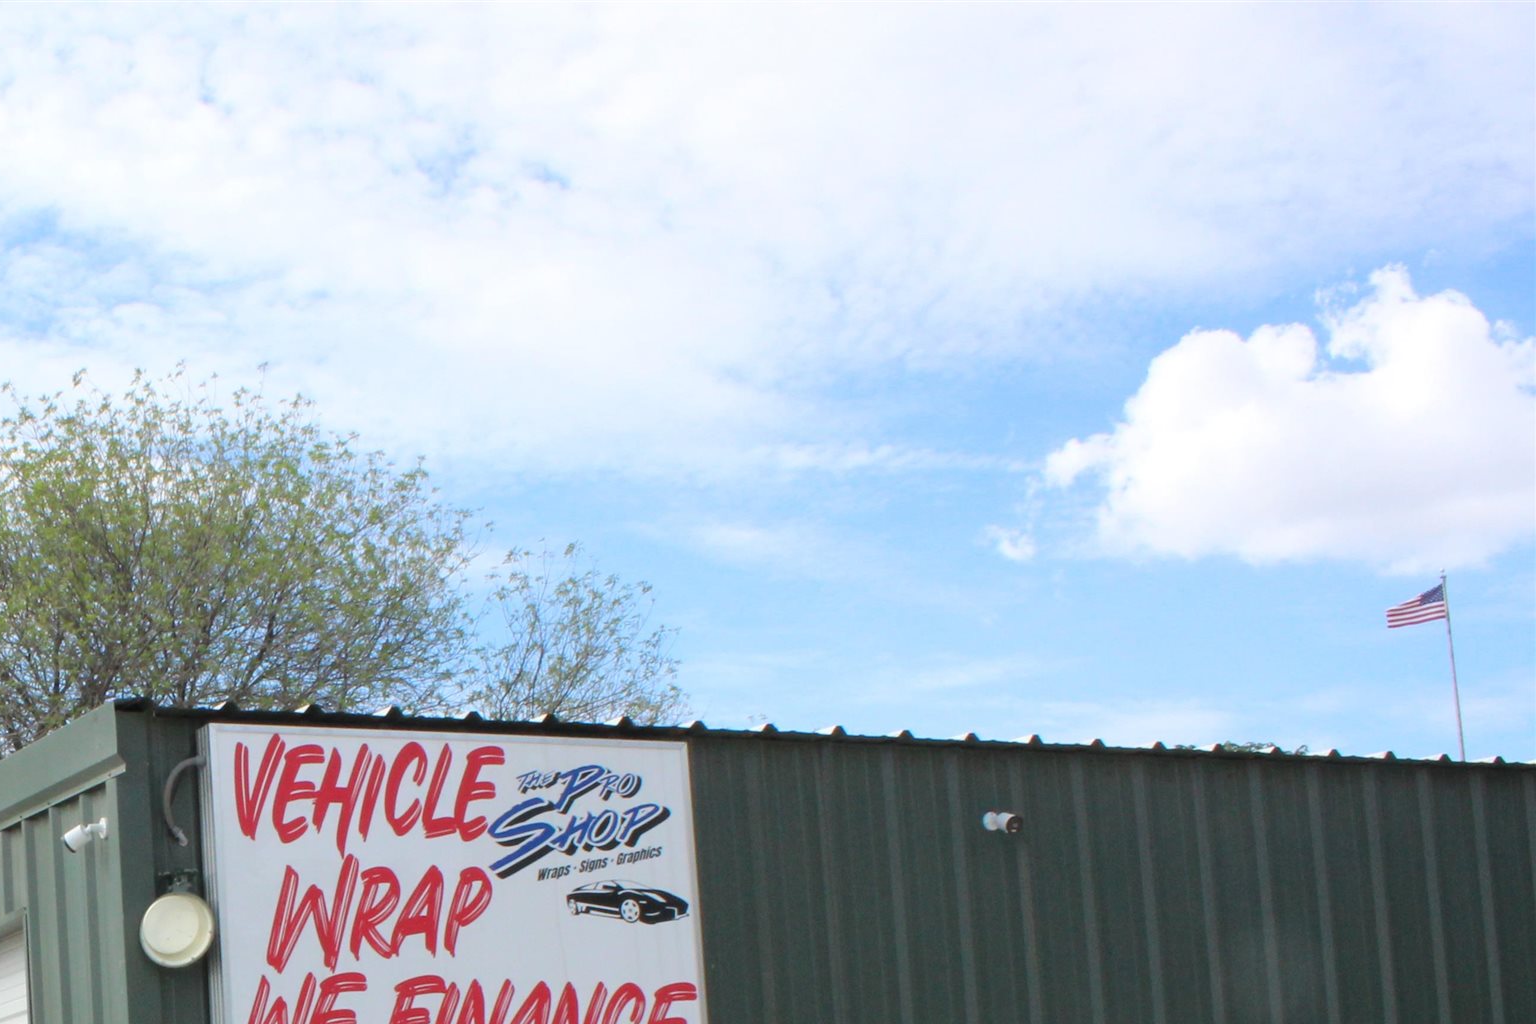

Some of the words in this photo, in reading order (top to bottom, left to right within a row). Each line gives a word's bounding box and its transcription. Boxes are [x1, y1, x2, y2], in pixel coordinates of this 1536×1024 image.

[234, 733, 505, 859] VEHICLE
[516, 770, 559, 794] THE
[553, 764, 642, 814] PRO
[487, 797, 671, 879] SHOP
[537, 864, 571, 881] Wraps
[579, 857, 607, 873] Signs
[616, 846, 662, 865] Graphics
[266, 852, 493, 974] WRAP
